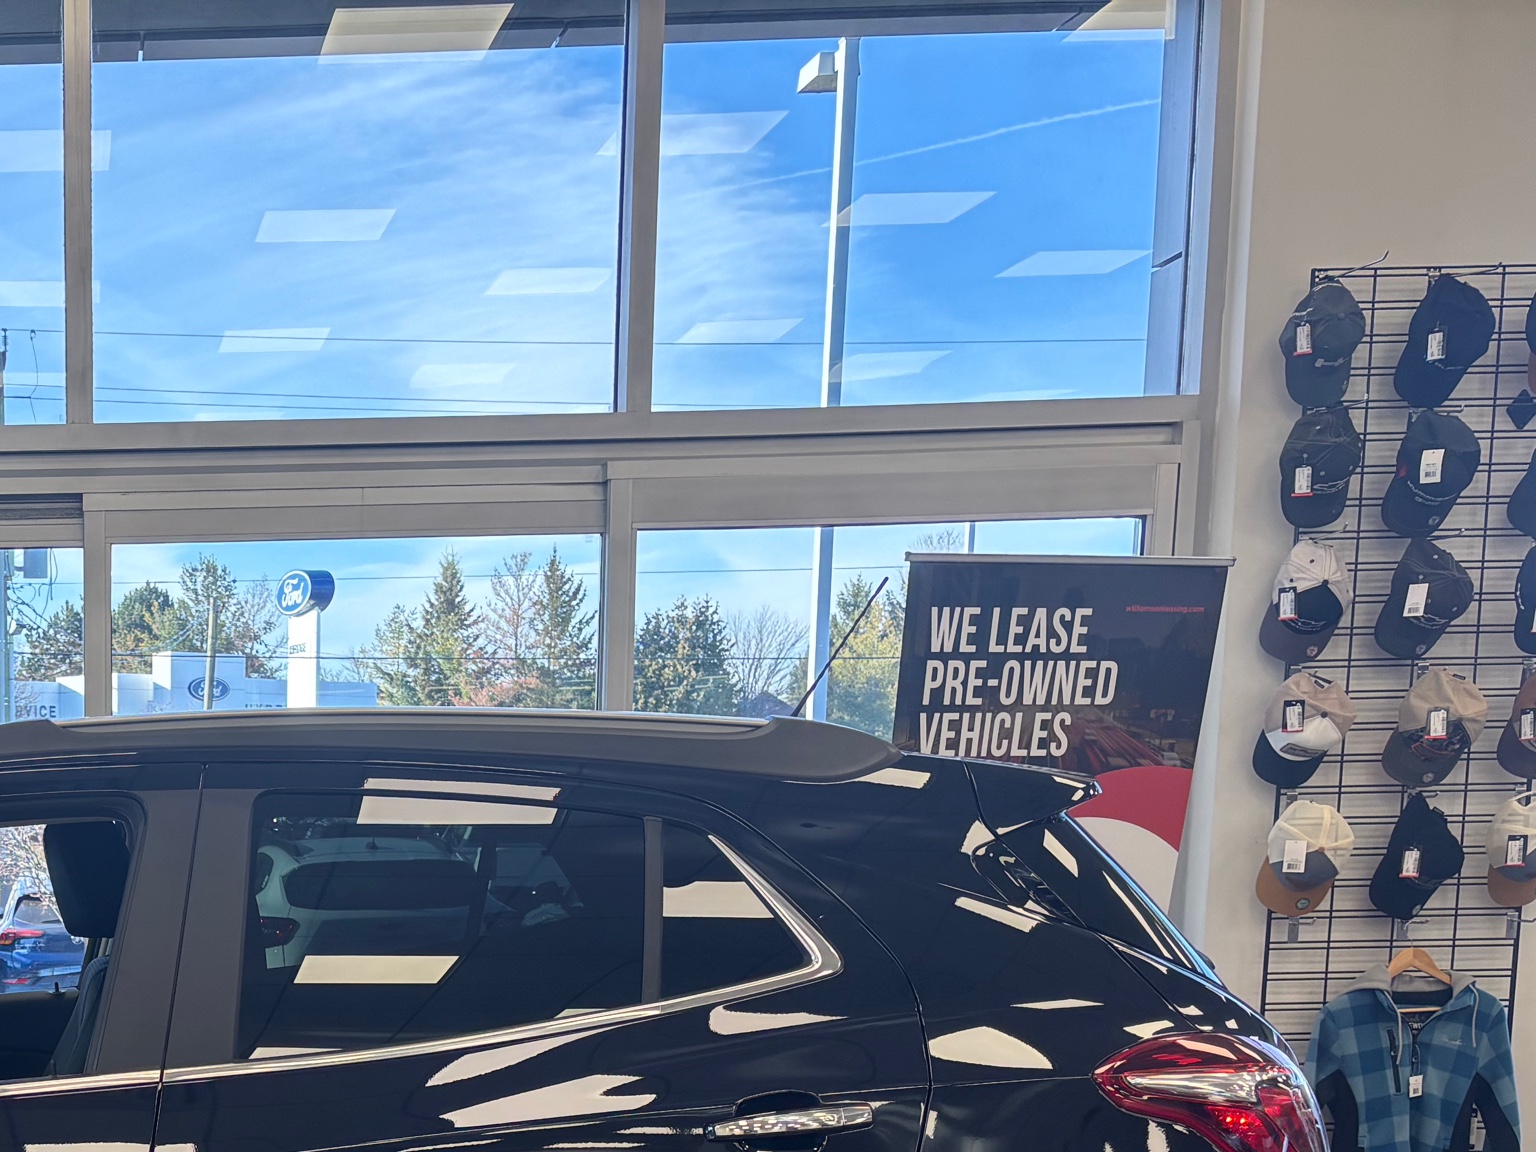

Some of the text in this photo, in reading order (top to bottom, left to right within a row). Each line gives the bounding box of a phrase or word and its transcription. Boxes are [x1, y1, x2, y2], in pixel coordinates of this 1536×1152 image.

[282, 578, 304, 608] Ford
[930, 606, 1093, 653] WE LEASE
[922, 660, 1119, 706] PRE-OWNED
[919, 712, 1072, 757] VEHICLES
